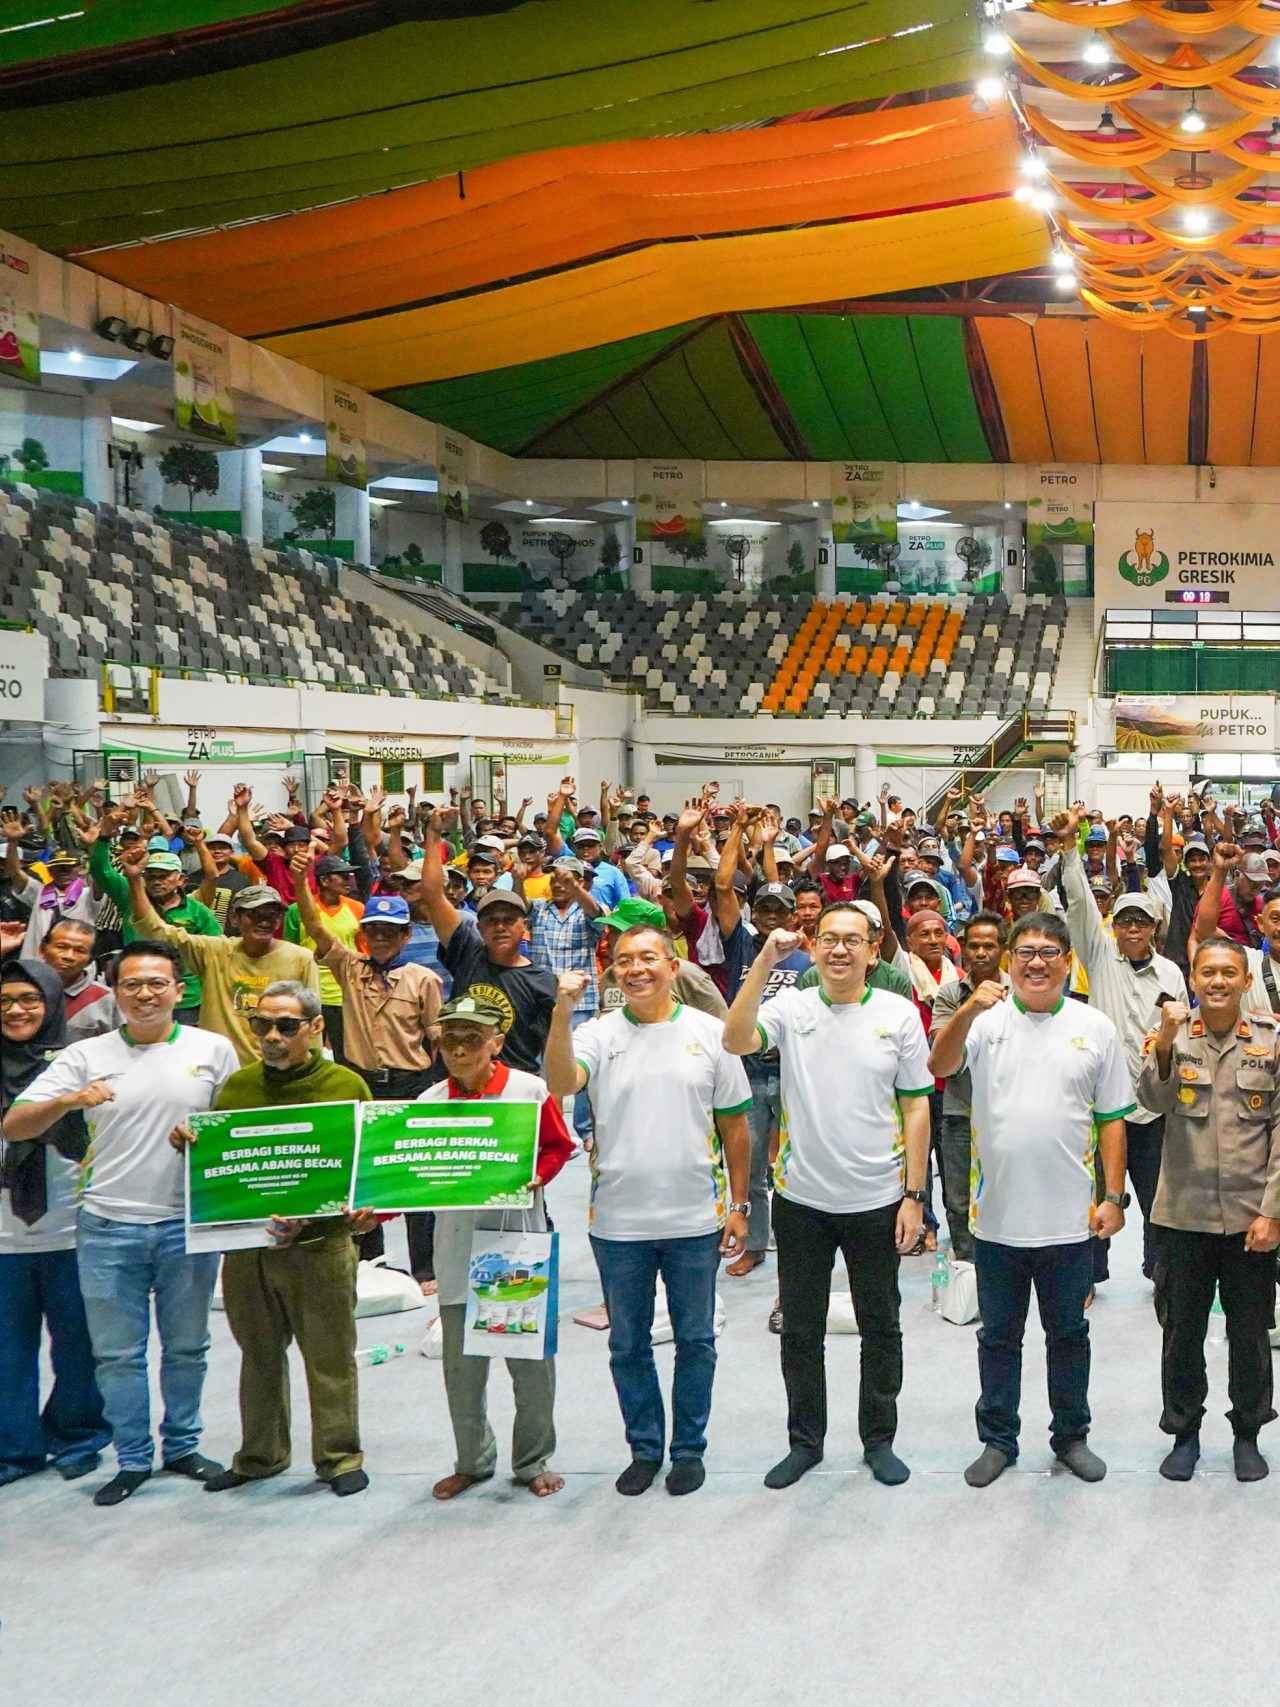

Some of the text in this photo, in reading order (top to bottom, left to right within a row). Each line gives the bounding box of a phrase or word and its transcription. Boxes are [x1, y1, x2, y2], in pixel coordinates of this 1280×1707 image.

[653, 471, 684, 480] PETRO
[1041, 475, 1077, 485] PETRO
[909, 542, 925, 551] ZA
[1178, 552, 1275, 567] PETROKIMIA
[1178, 570, 1236, 584] GRESIK
[187, 728, 217, 740] PETRO
[1218, 724, 1268, 736] PETRO
[187, 742, 235, 760] ZA PLUS
[368, 746, 422, 760] PHOSGREEN
[724, 751, 780, 759] PETROGANIK
[953, 754, 972, 764] ZA
[394, 1136, 498, 1150] BERBAGI BERKAH
[222, 1144, 321, 1161] BERBAGI BERKAH
[373, 1151, 519, 1167] BERSAMA ABANG BECAK
[204, 1163, 259, 1179] BERSAMA
[261, 1159, 303, 1171] ABANG
[304, 1158, 342, 1169] BECAK
